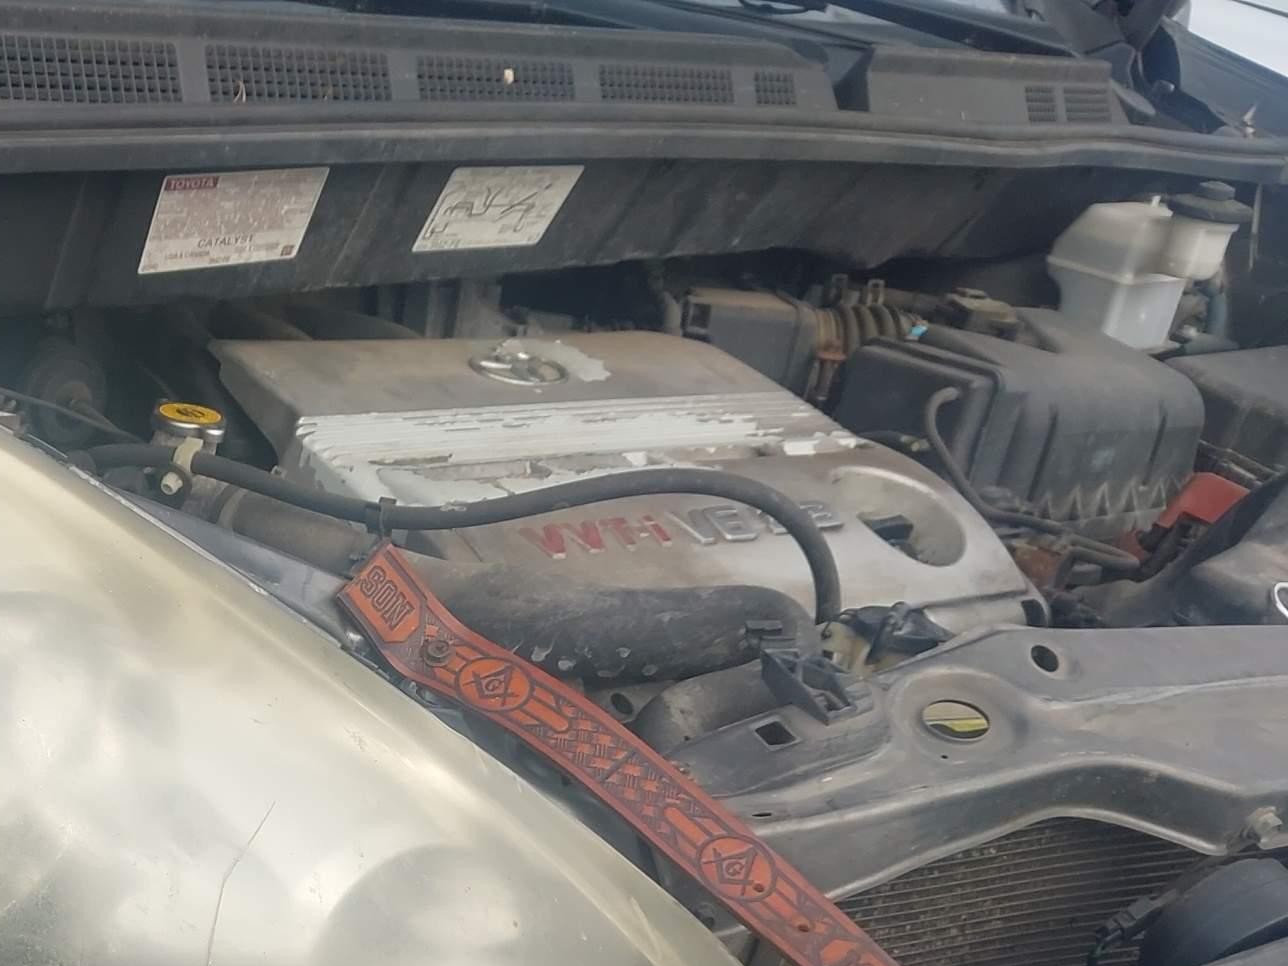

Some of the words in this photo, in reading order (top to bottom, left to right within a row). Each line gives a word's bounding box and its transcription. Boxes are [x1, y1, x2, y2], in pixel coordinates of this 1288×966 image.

[169, 178, 216, 191] TOYOTA
[196, 233, 254, 249] CATALYST
[359, 565, 416, 631] SON
